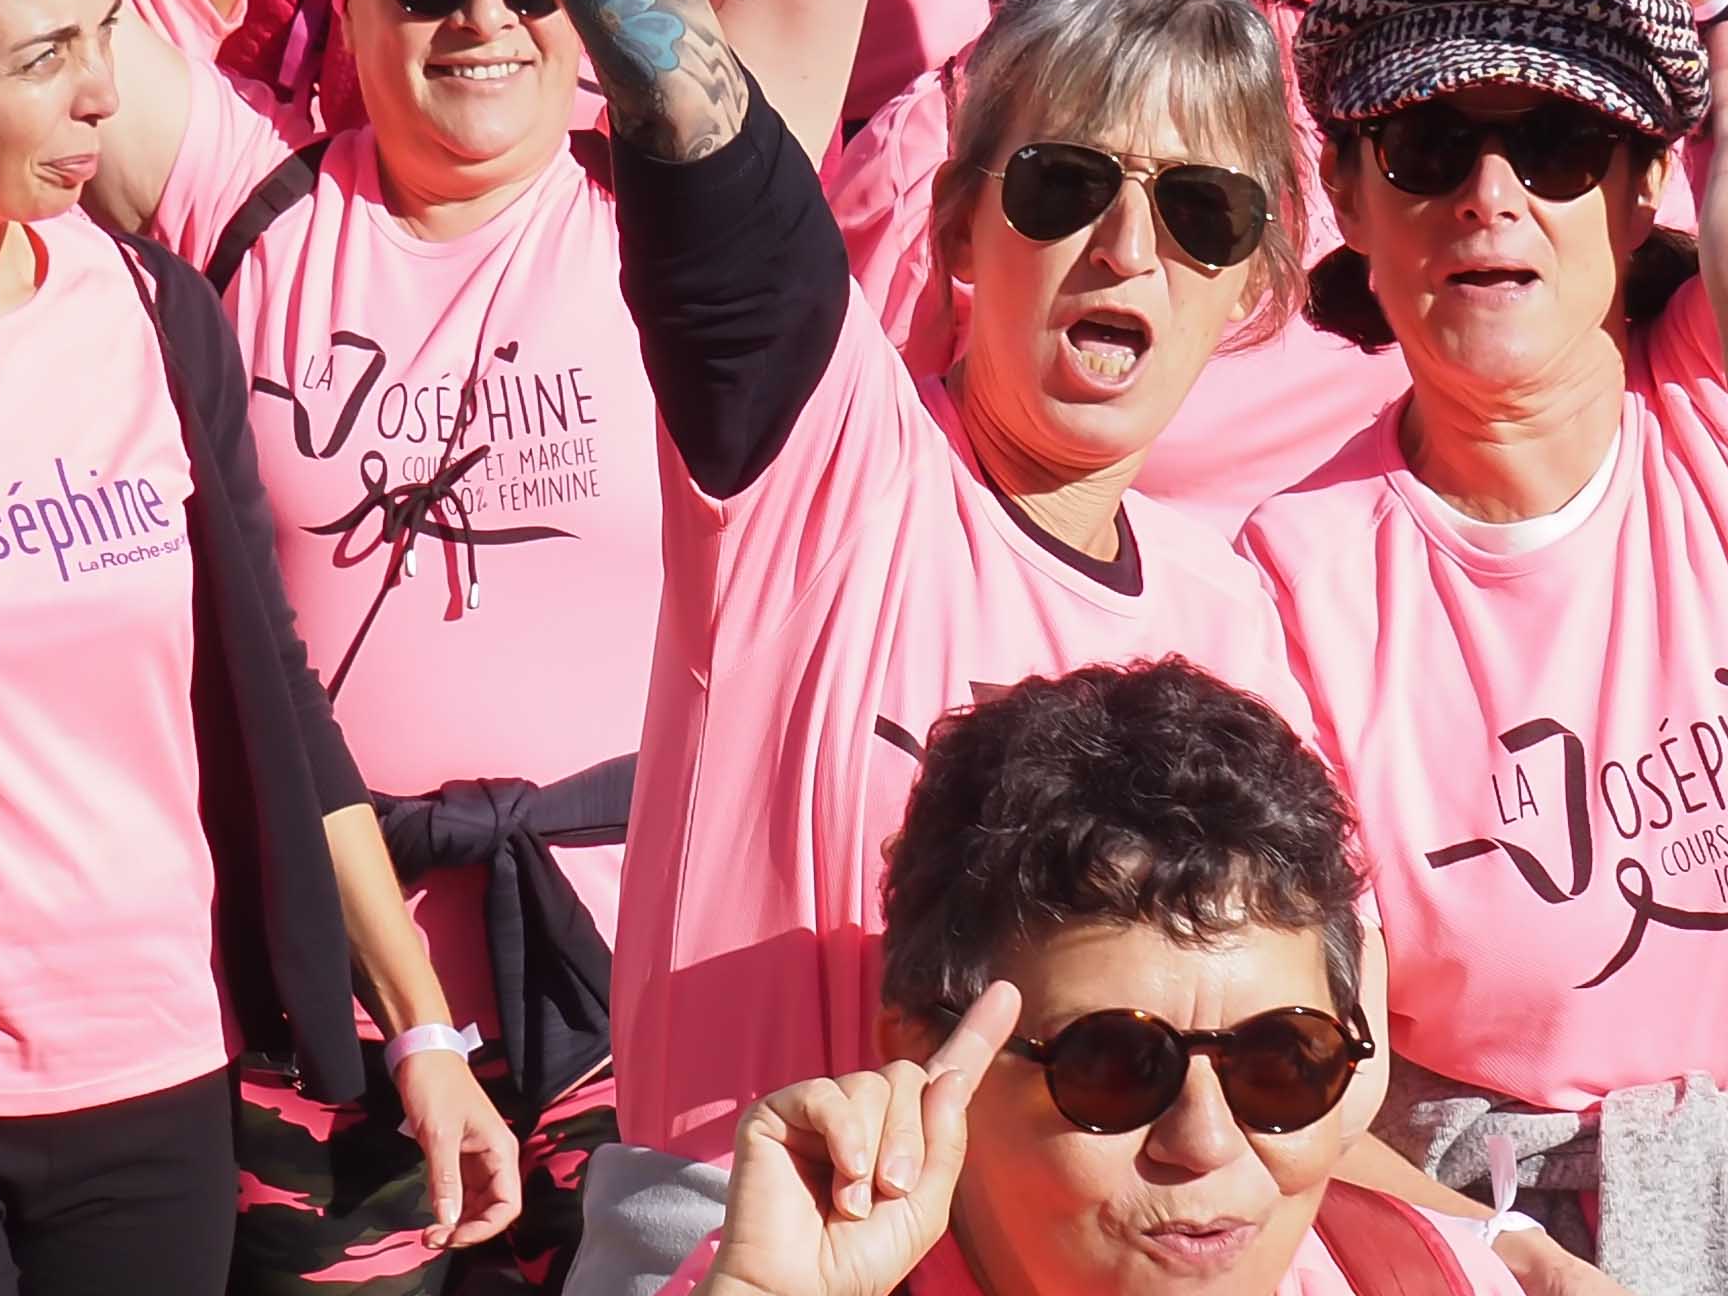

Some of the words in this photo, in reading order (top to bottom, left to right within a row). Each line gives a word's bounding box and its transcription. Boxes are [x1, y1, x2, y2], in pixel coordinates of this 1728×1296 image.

[302, 354, 335, 392] LA
[485, 453, 504, 481] ET
[519, 437, 599, 475] MARCHE
[498, 468, 601, 512] FÉMININE
[1491, 764, 1540, 826] LA
